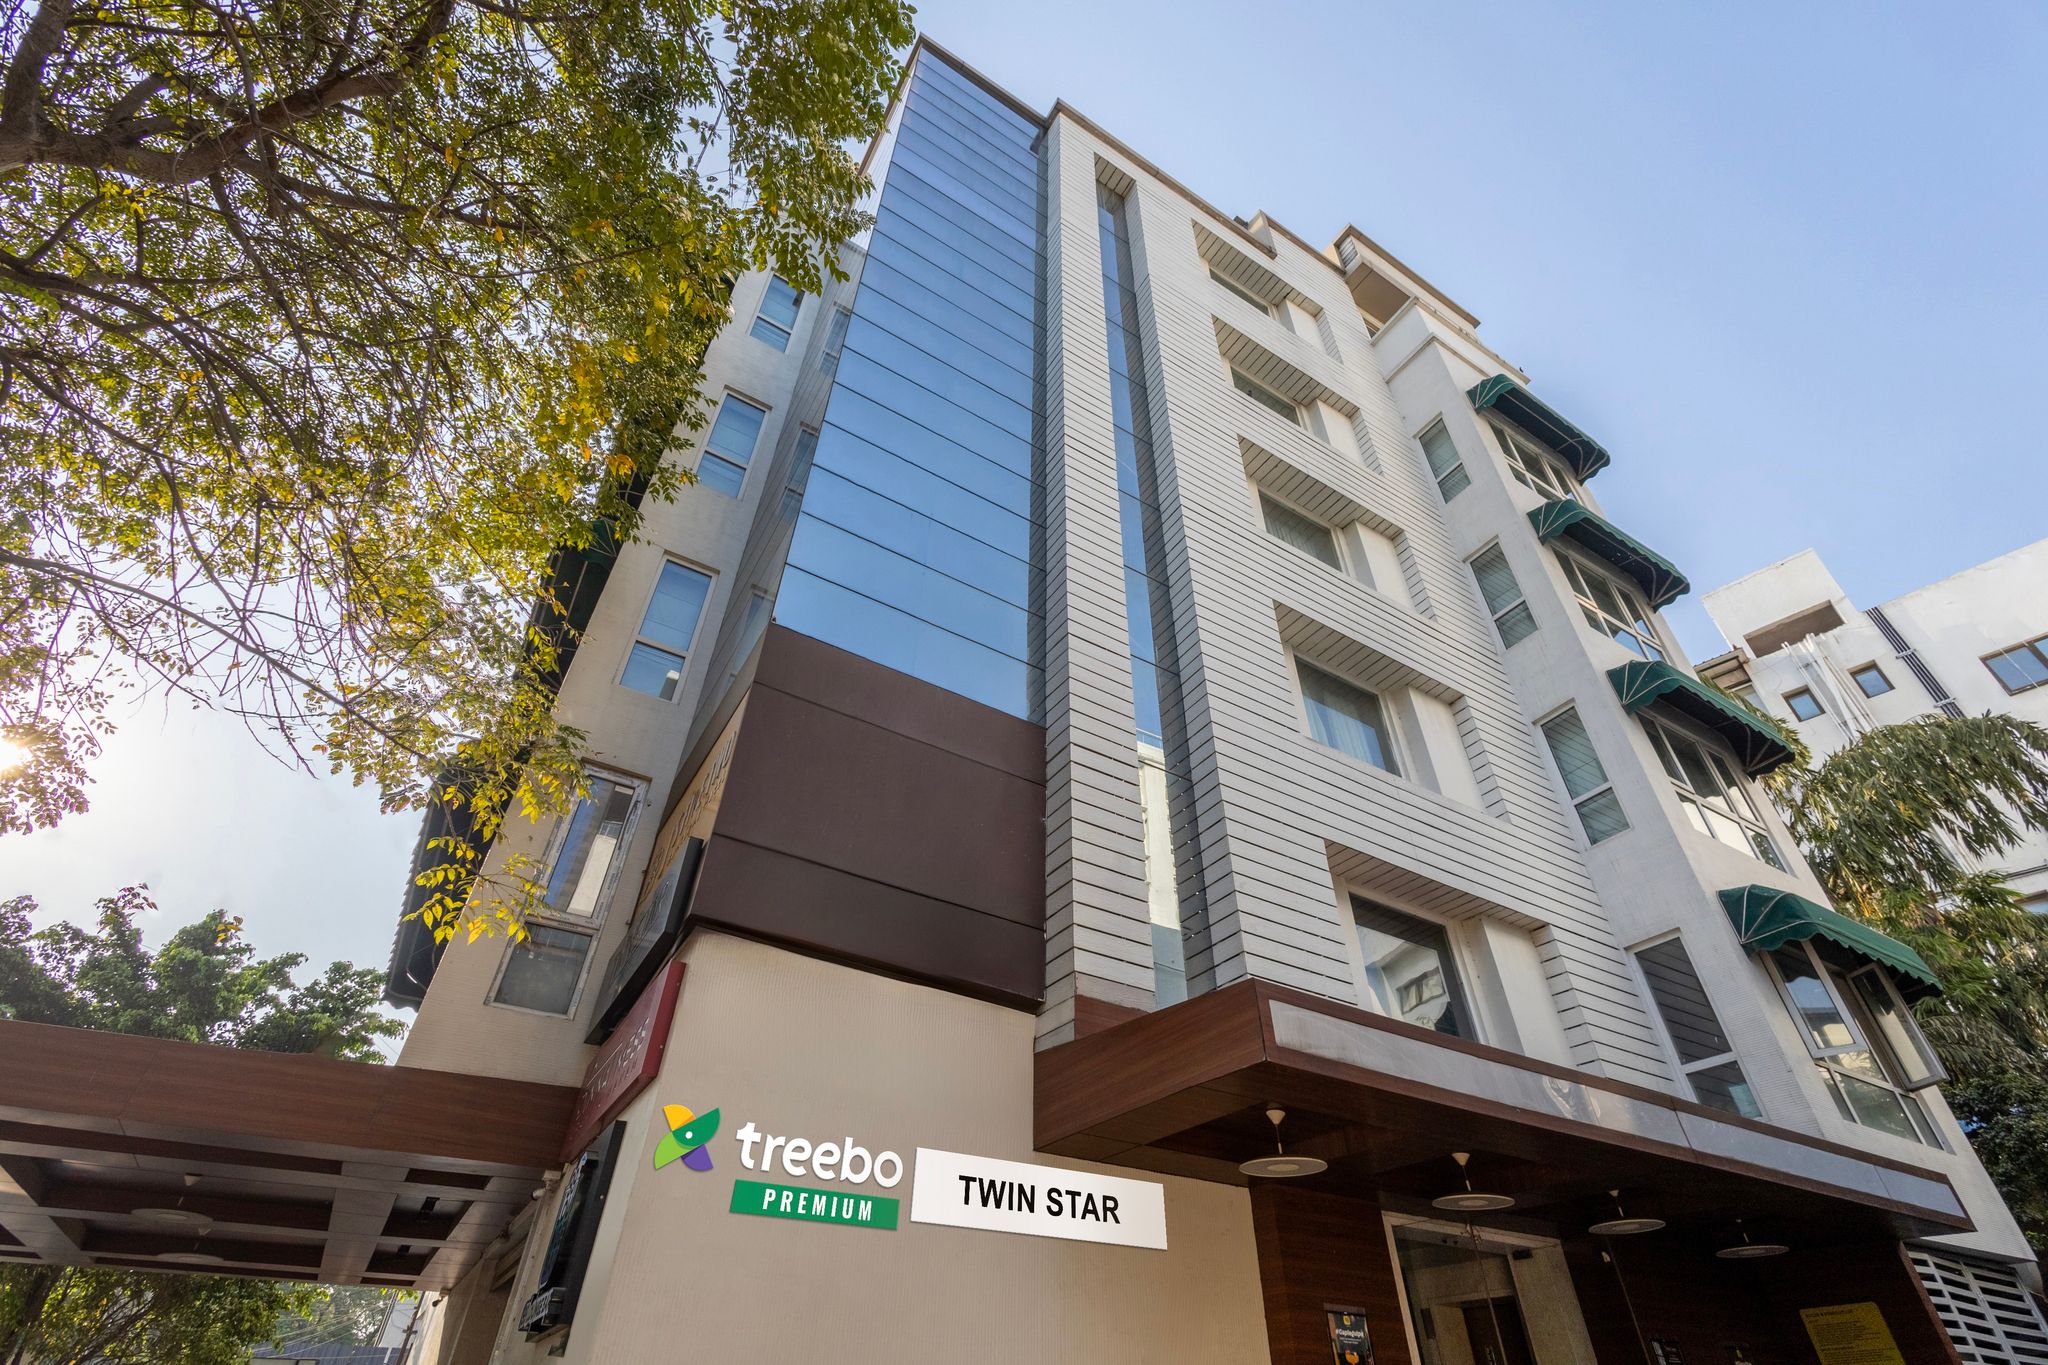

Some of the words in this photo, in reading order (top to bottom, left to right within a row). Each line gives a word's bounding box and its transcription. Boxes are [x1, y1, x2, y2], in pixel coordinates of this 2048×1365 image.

[735, 1121, 904, 1188] treebo
[762, 1188, 873, 1222] PREMIUM
[958, 1174, 1036, 1214] TWIN
[1046, 1187, 1121, 1225] STAR
